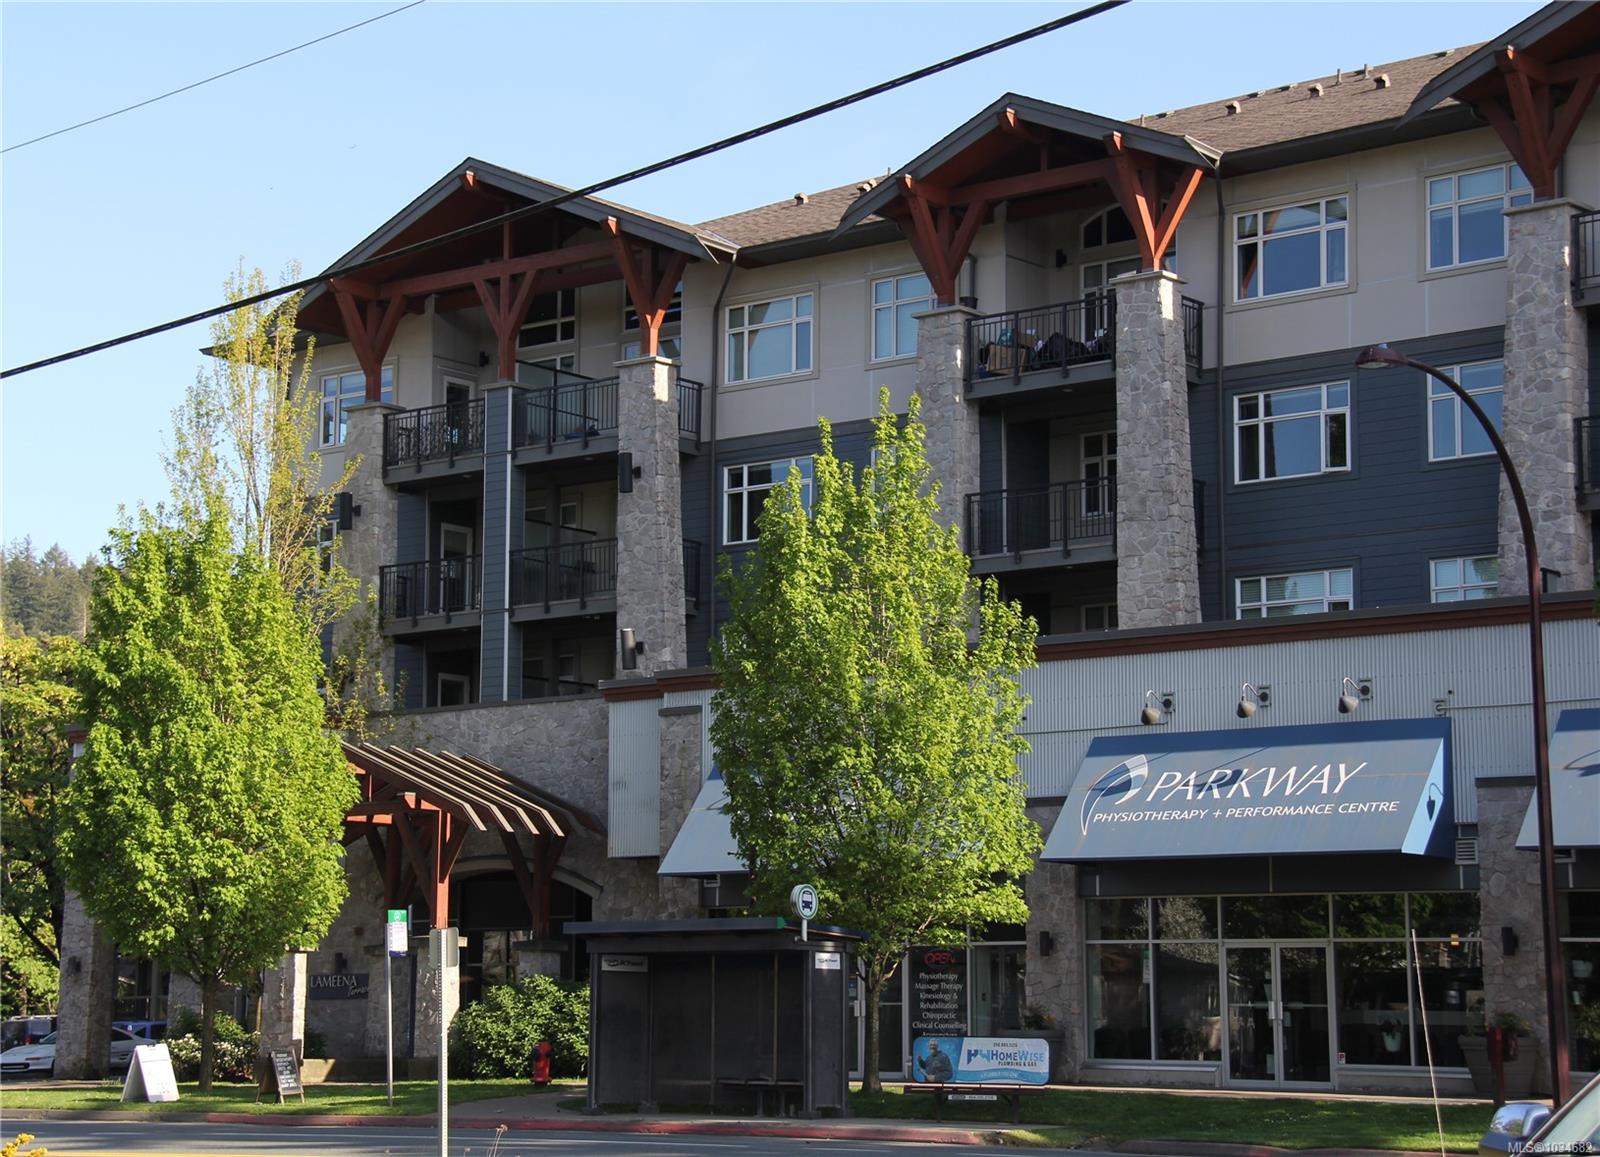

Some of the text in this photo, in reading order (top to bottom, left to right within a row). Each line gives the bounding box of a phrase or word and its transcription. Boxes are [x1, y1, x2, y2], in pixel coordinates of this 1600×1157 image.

[1146, 762, 1367, 802] PARKWAY
[1093, 808, 1208, 823] PHYSIOTHERAPY
[1226, 803, 1333, 818] PERFORMANCE
[1338, 801, 1400, 814] CENTRE
[310, 975, 357, 988] LAMEENA
[919, 973, 959, 982] Physiotherapy
[915, 982, 963, 992] Massage Therapy
[919, 992, 952, 1001] Kinesiology
[922, 1011, 957, 1020] Chiropractic
[912, 1021, 933, 1029] Clinical
